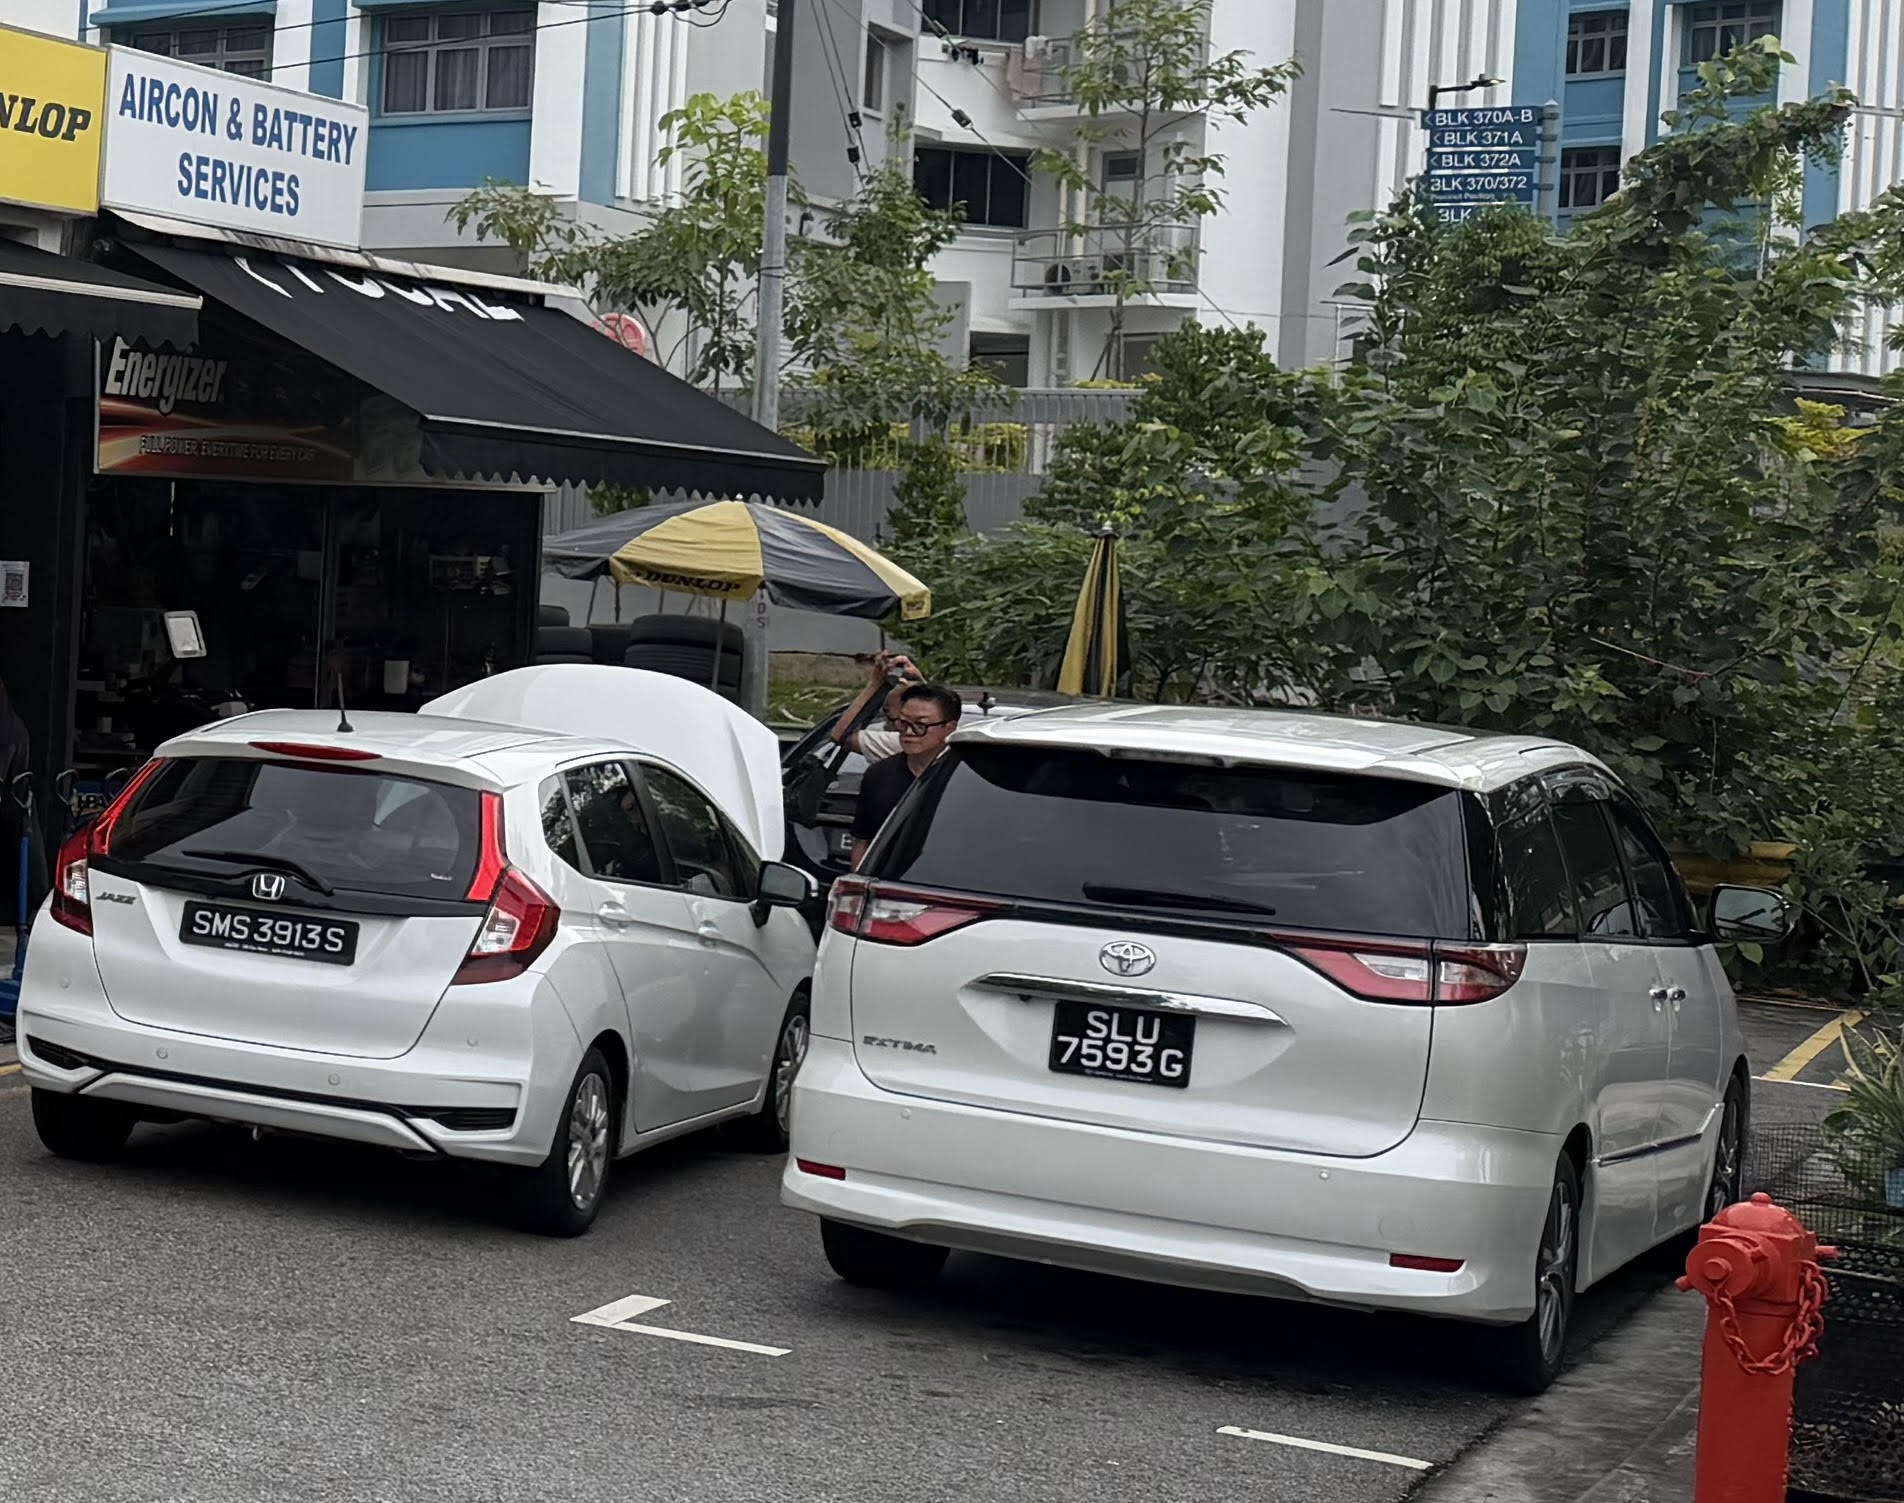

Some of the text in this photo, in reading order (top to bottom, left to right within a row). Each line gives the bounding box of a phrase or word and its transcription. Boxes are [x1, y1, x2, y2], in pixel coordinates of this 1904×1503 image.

[118, 71, 357, 168] AIRCON & BATTERY
[1435, 108, 1534, 126] BLK 370A-B
[1443, 131, 1523, 145] BLK 371A
[1441, 153, 1521, 167] BLK 372A
[176, 151, 301, 218] SERVICES
[1430, 176, 1528, 191] BLK 370/372
[104, 336, 228, 416] Energizer
[644, 570, 742, 593] DUNLOP
[1085, 1010, 1162, 1045] SLU
[1056, 1035, 1185, 1078] 7593G
